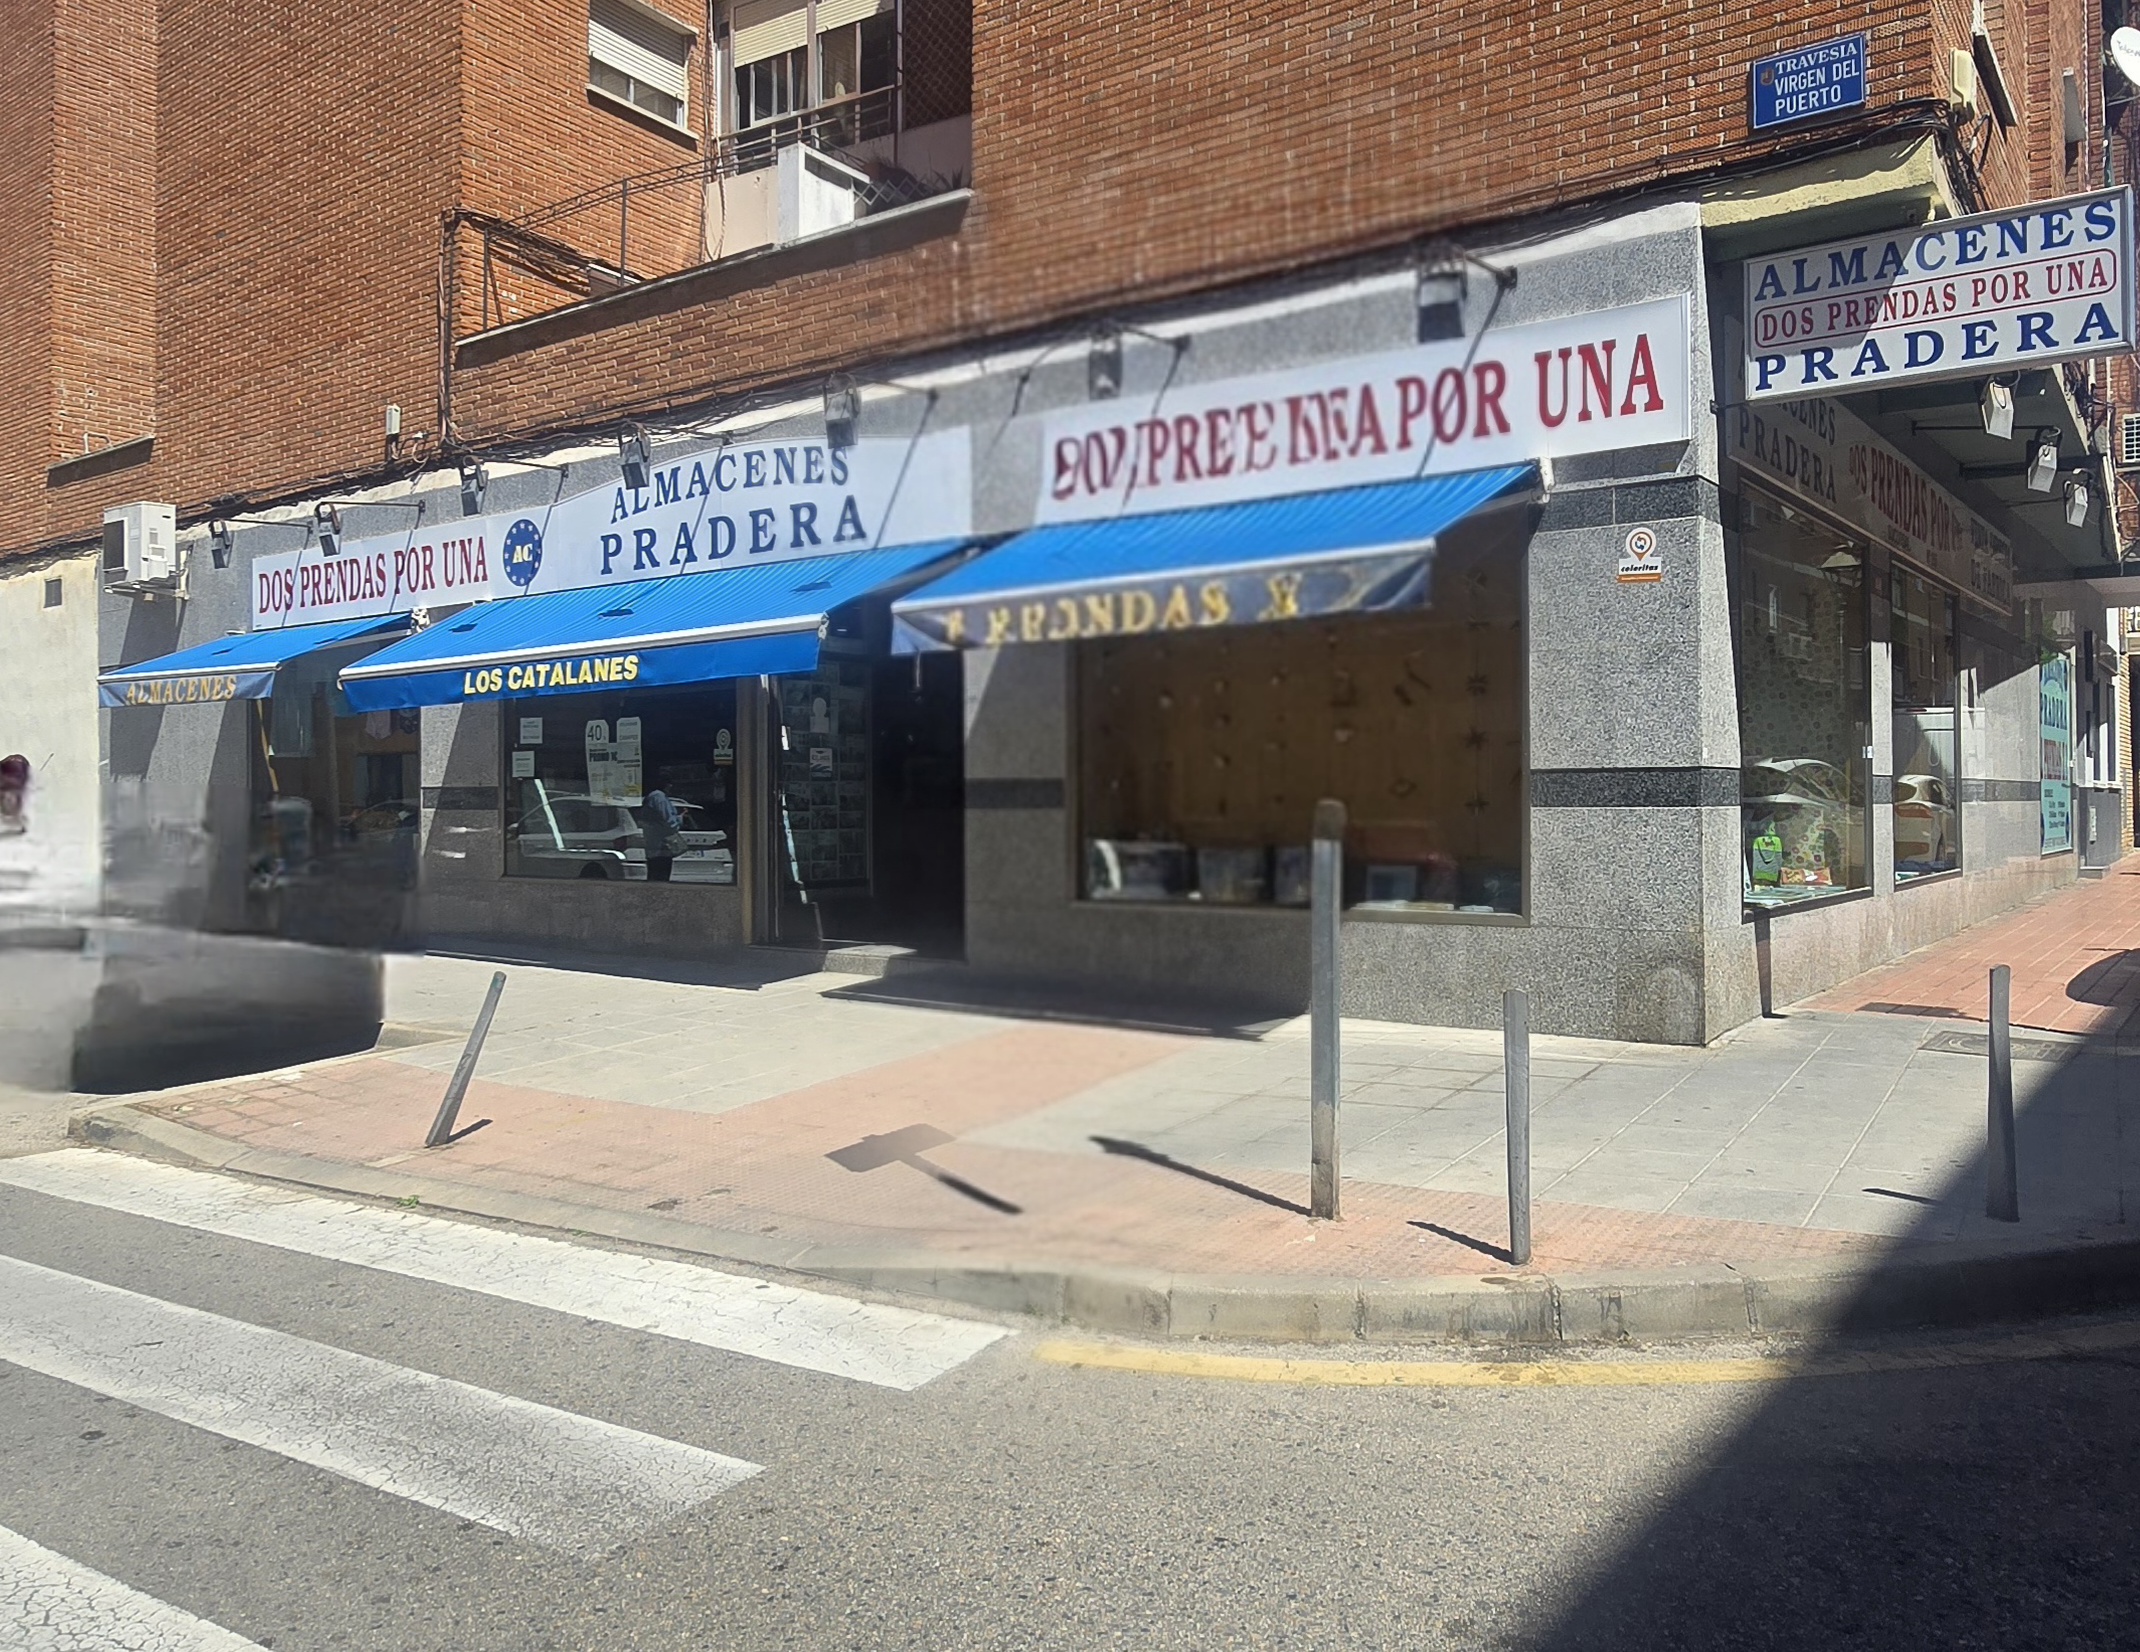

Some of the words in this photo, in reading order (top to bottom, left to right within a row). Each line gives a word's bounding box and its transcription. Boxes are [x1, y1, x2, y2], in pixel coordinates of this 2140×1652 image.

[1774, 67, 1826, 95] VIRGEN
[1832, 59, 1859, 81] DEL
[1776, 43, 1858, 74] TRAVESIA
[1775, 85, 1841, 117] PUERTO
[1755, 200, 2116, 301] ALMACENES
[1763, 308, 1814, 342] DOS
[1829, 283, 1957, 330] PRENDAS
[1972, 273, 2031, 307] POR
[2047, 257, 2108, 295] UNA
[1756, 302, 2119, 392] PRADERA
[1396, 359, 1511, 450] POR
[1534, 333, 1664, 428] UNA
[611, 446, 849, 524] ALMACENES
[1739, 405, 1837, 503] PRADERA
[1870, 446, 1928, 544] PRENDAS
[512, 544, 533, 563] AC
[600, 495, 867, 575] PRADERA
[259, 571, 293, 613] DOS
[300, 553, 386, 608] PRENDAS
[394, 544, 435, 594] POR
[443, 537, 488, 587] UNA
[126, 676, 237, 705] ALMACENES
[464, 668, 503, 694] LOS
[507, 655, 639, 690] CATALANES
[587, 724, 602, 741] 40
